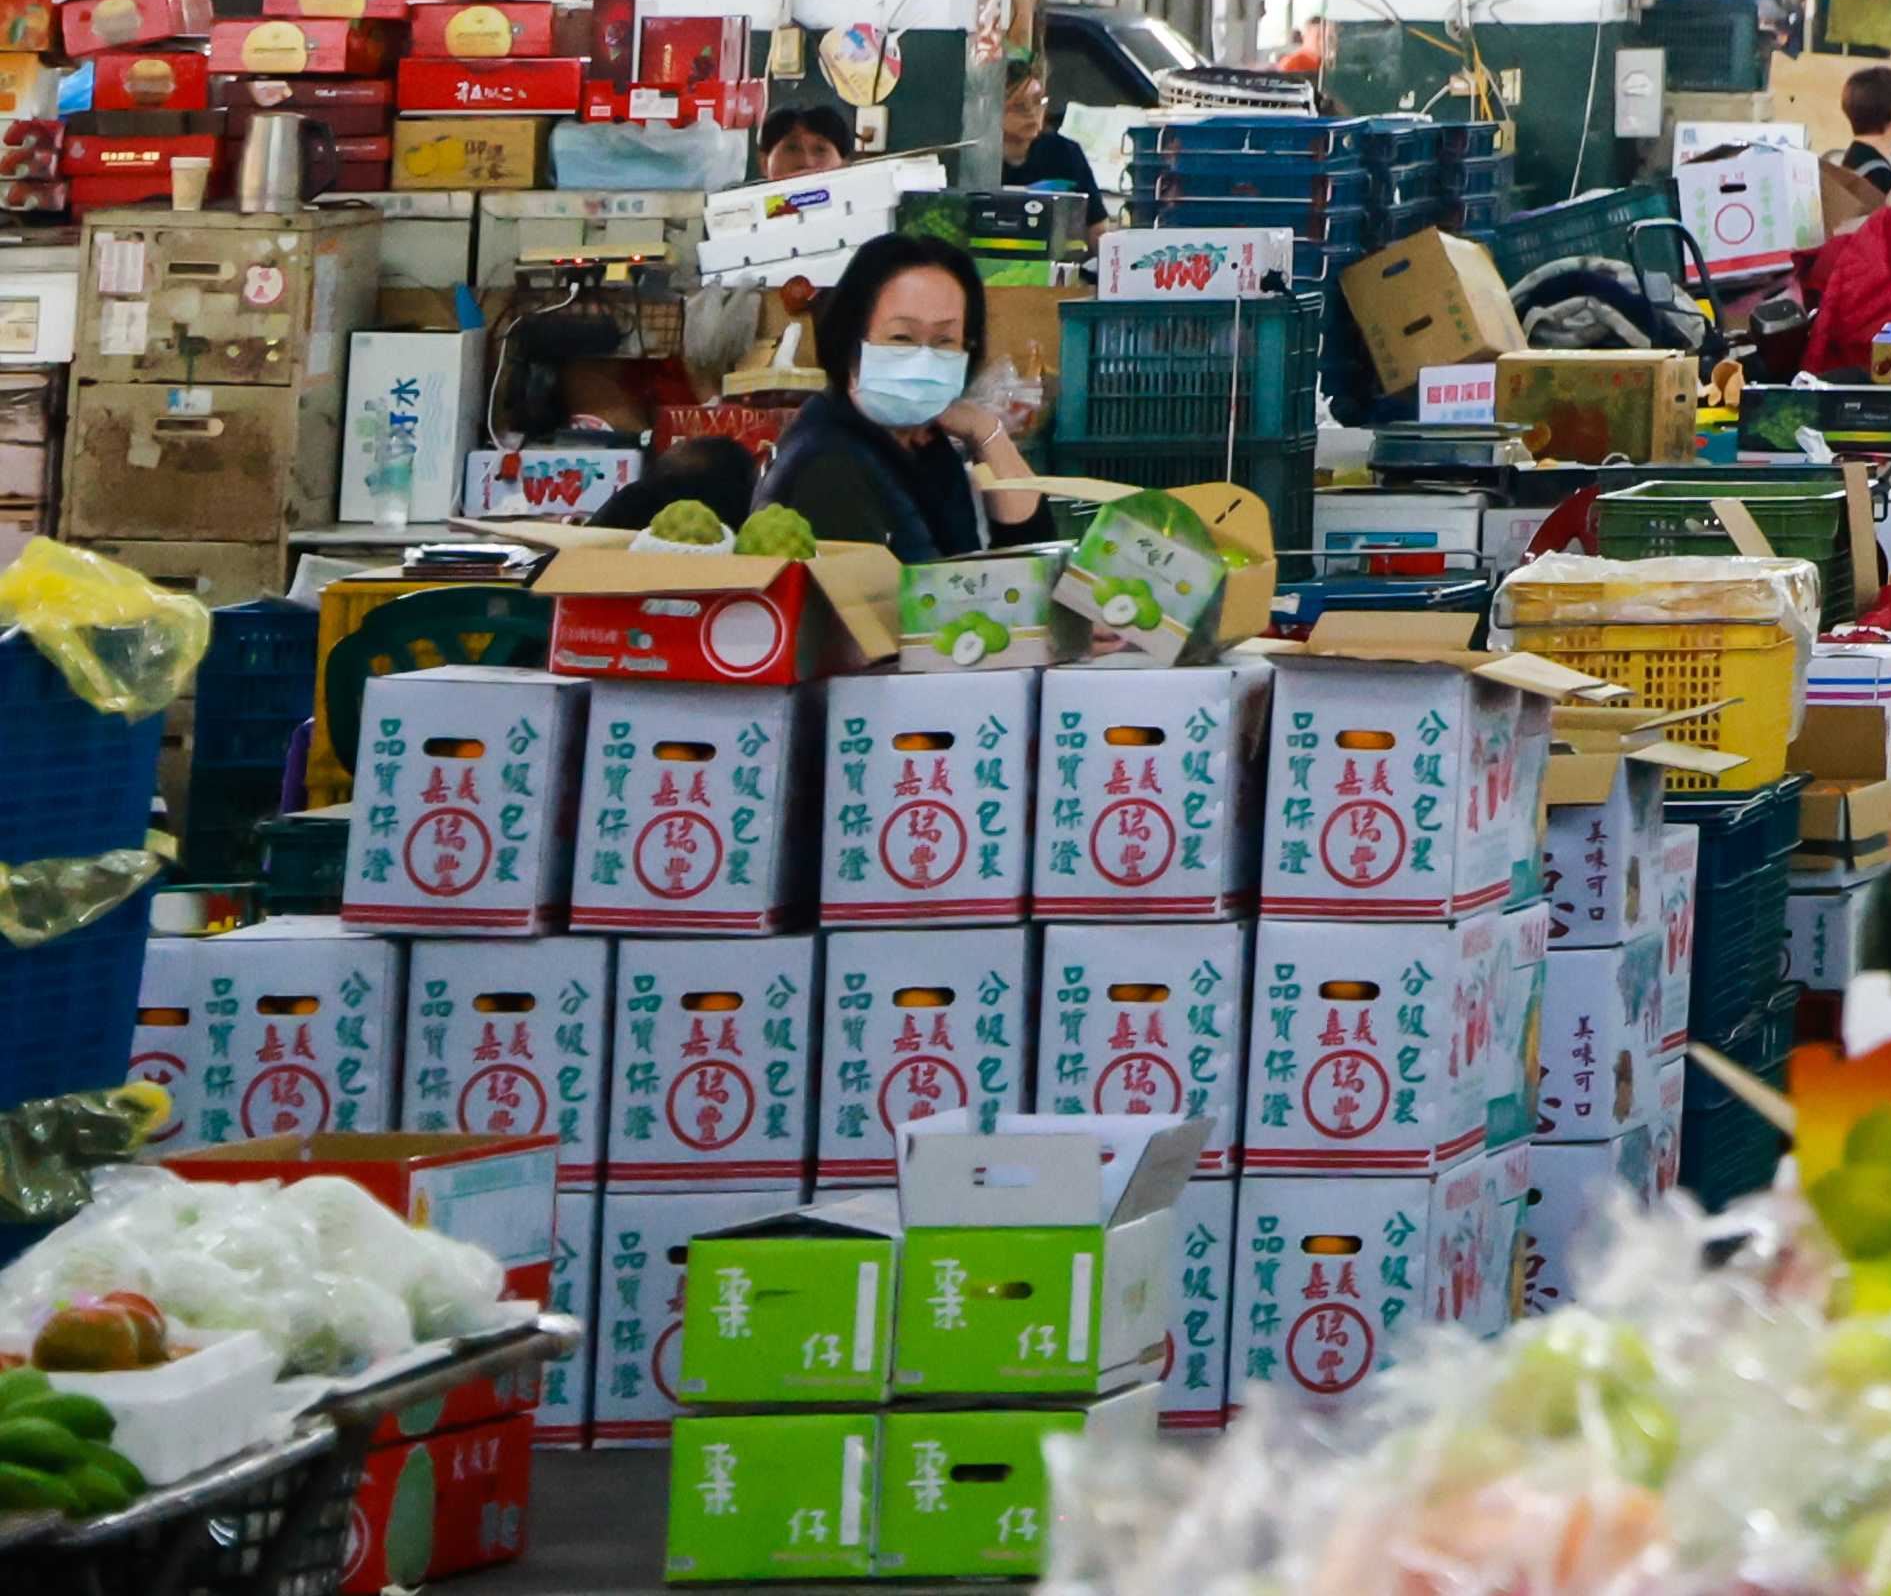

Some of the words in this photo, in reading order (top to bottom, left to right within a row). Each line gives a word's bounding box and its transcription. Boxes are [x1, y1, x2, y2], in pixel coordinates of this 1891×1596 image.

[419, 767, 482, 807] 嘉義
[649, 767, 715, 812] 嘉義
[893, 757, 957, 799] 嘉義
[1102, 757, 1165, 798] 嘉義
[1333, 759, 1396, 801] 嘉義
[1584, 819, 1609, 921] 美味可口
[257, 1025, 319, 1065] 嘉義
[472, 1024, 535, 1063] 嘉義
[681, 1019, 745, 1060] 嘉義
[892, 1014, 957, 1055] 嘉義
[1106, 1012, 1171, 1056] 嘉義
[1317, 1009, 1379, 1052] 嘉義
[1573, 1015, 1593, 1117] 美味可口
[1302, 1263, 1363, 1302] 嘉義
